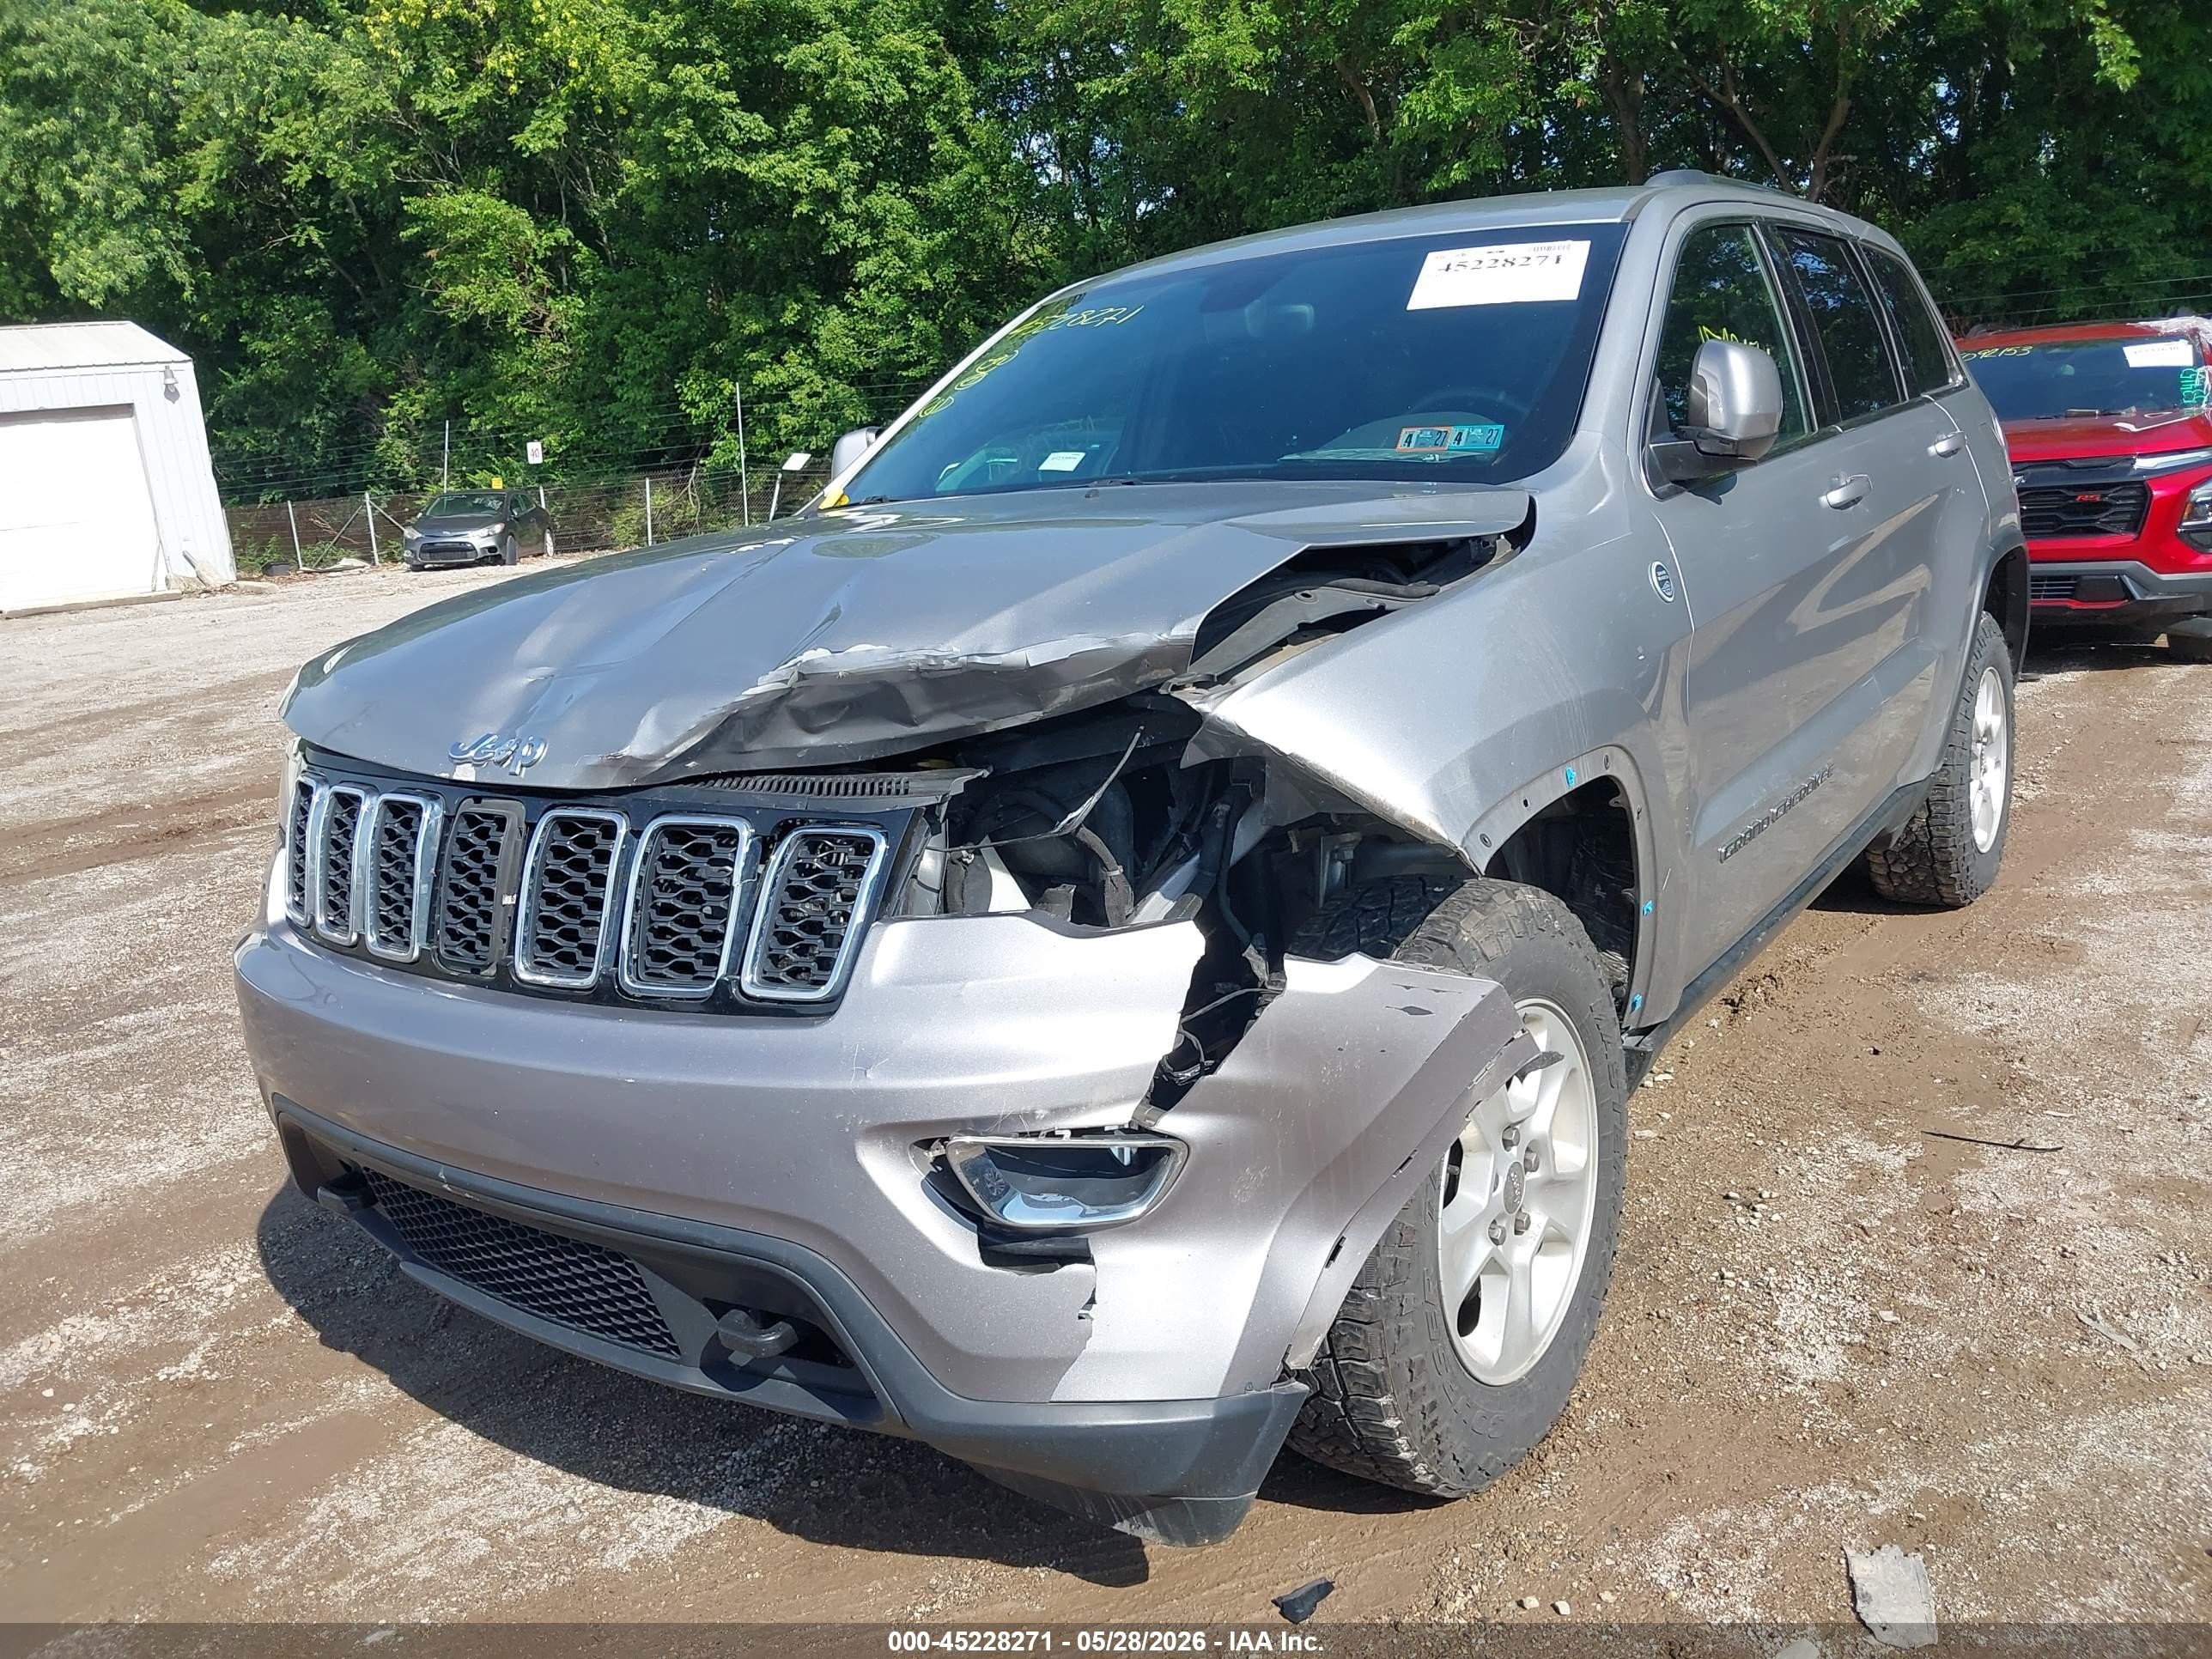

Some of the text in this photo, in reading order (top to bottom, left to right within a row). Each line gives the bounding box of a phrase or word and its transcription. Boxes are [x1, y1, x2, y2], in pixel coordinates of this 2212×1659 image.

[1437, 255, 1563, 272] 45228271
[1404, 430, 1448, 447] 4 27
[1453, 428, 1498, 446] 4 27
[448, 732, 548, 777] Jeep
